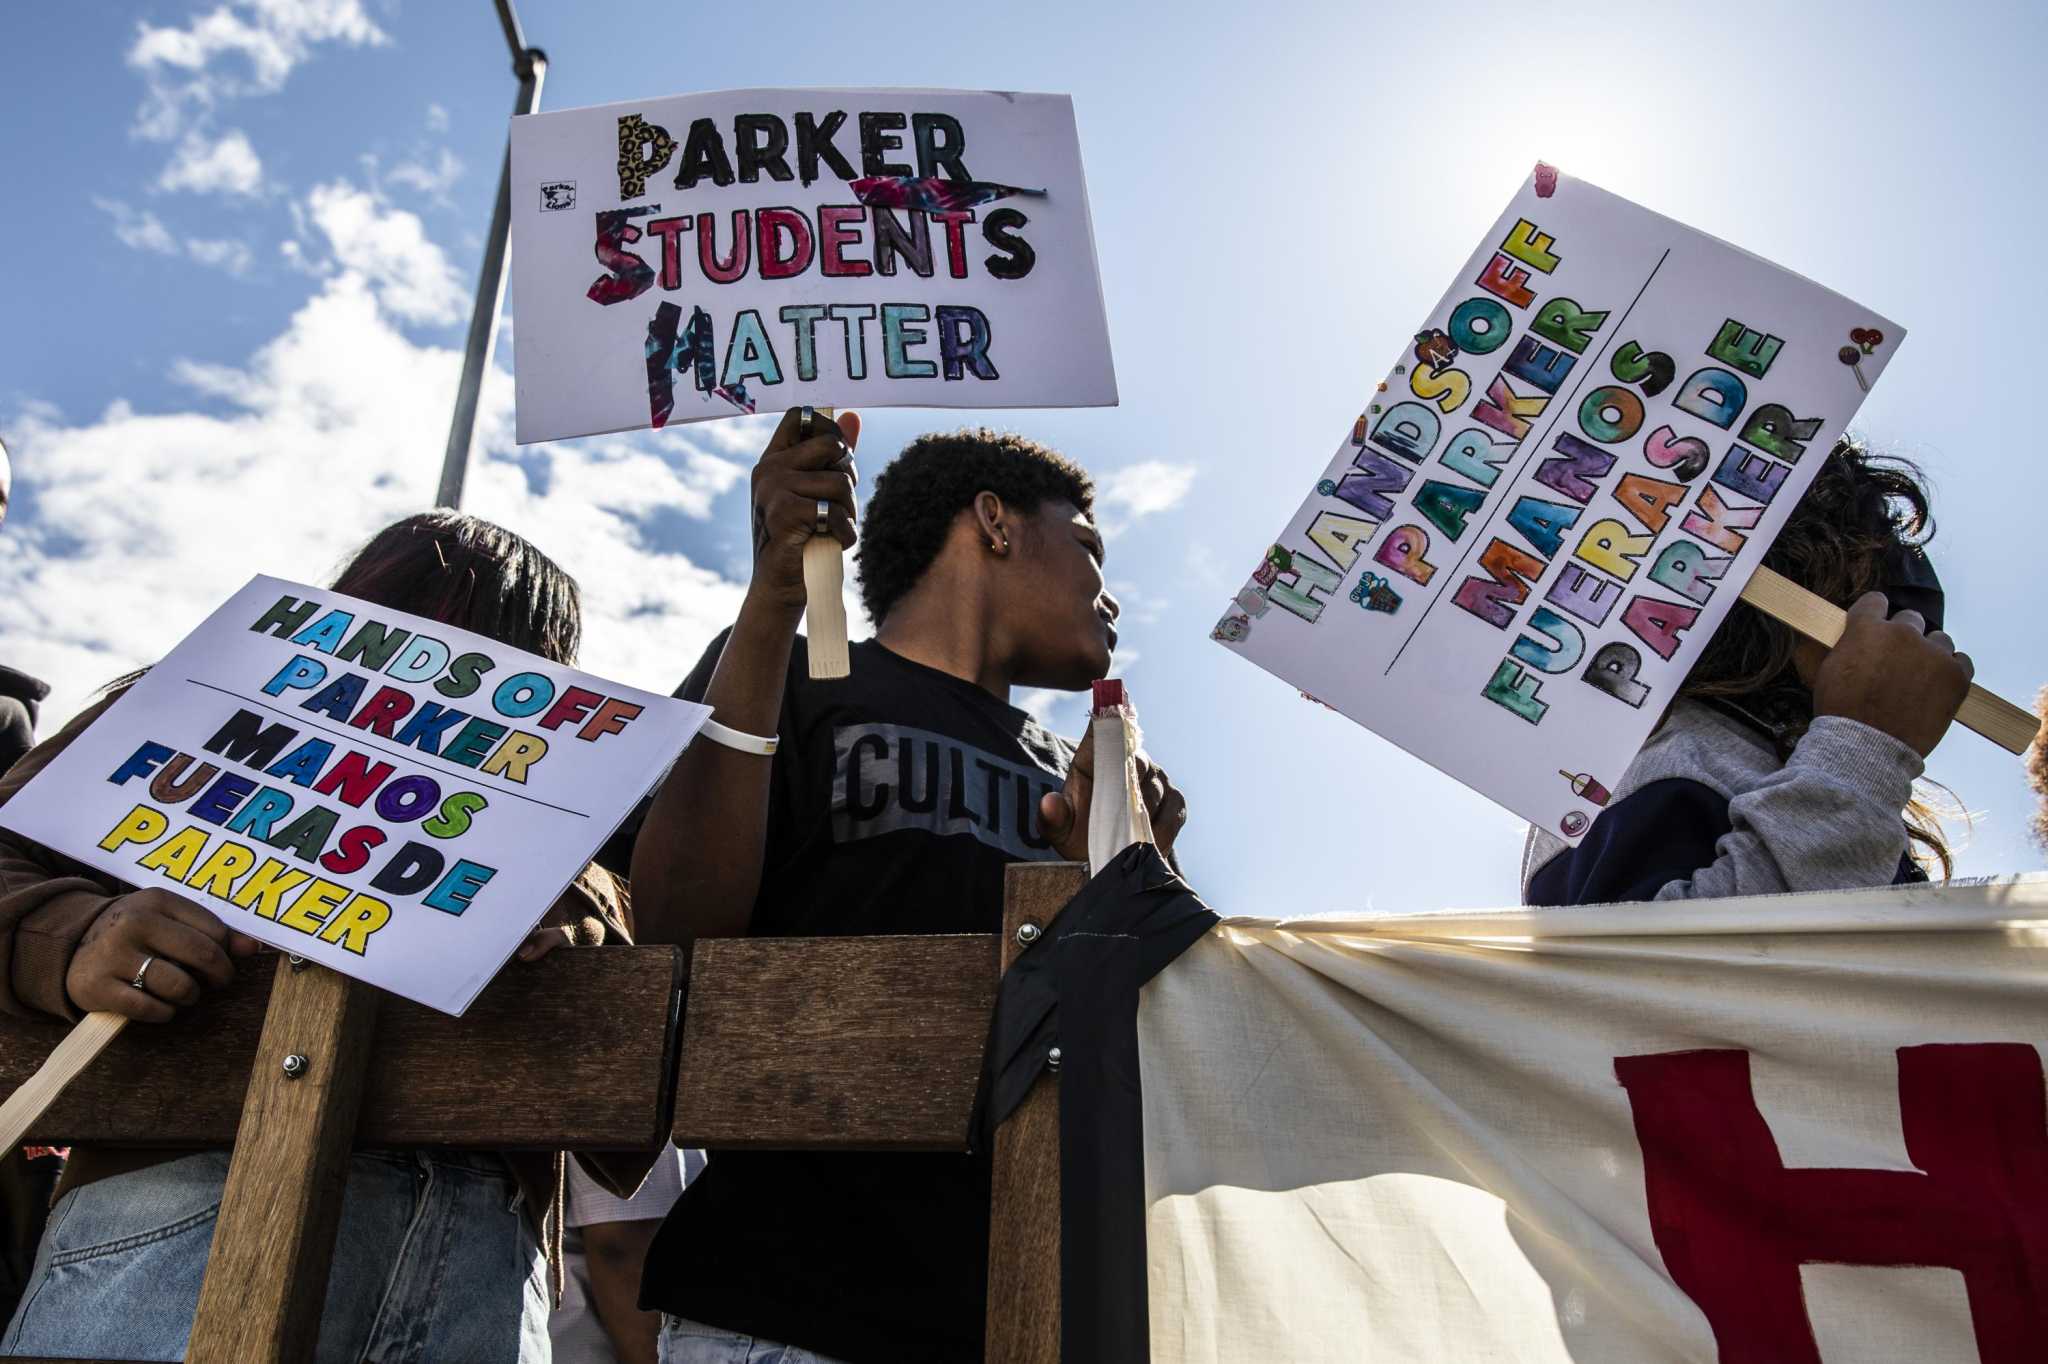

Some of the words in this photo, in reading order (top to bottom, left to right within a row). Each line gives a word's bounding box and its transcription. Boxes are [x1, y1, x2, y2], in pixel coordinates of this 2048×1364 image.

[617, 110, 973, 201] PARKER
[586, 203, 1036, 306] STUDENTS
[645, 301, 1000, 430] MATTER
[1266, 352, 1473, 624] HANDS
[1447, 217, 1562, 356] OFF
[1373, 297, 1611, 587] PARKER
[1451, 340, 1676, 631] MANOS
[1480, 424, 1711, 726] FUERAS
[1671, 317, 1786, 431] DE
[1580, 402, 1825, 710] PARKER
[248, 594, 496, 699] HANDS
[491, 671, 645, 743] OFF
[261, 653, 549, 785] PARKER
[107, 741, 390, 876] FUERAS
[370, 839, 499, 917] DE
[202, 707, 489, 840] MANOS
[96, 803, 393, 957] PARKER
[1613, 1042, 2048, 1364] H
